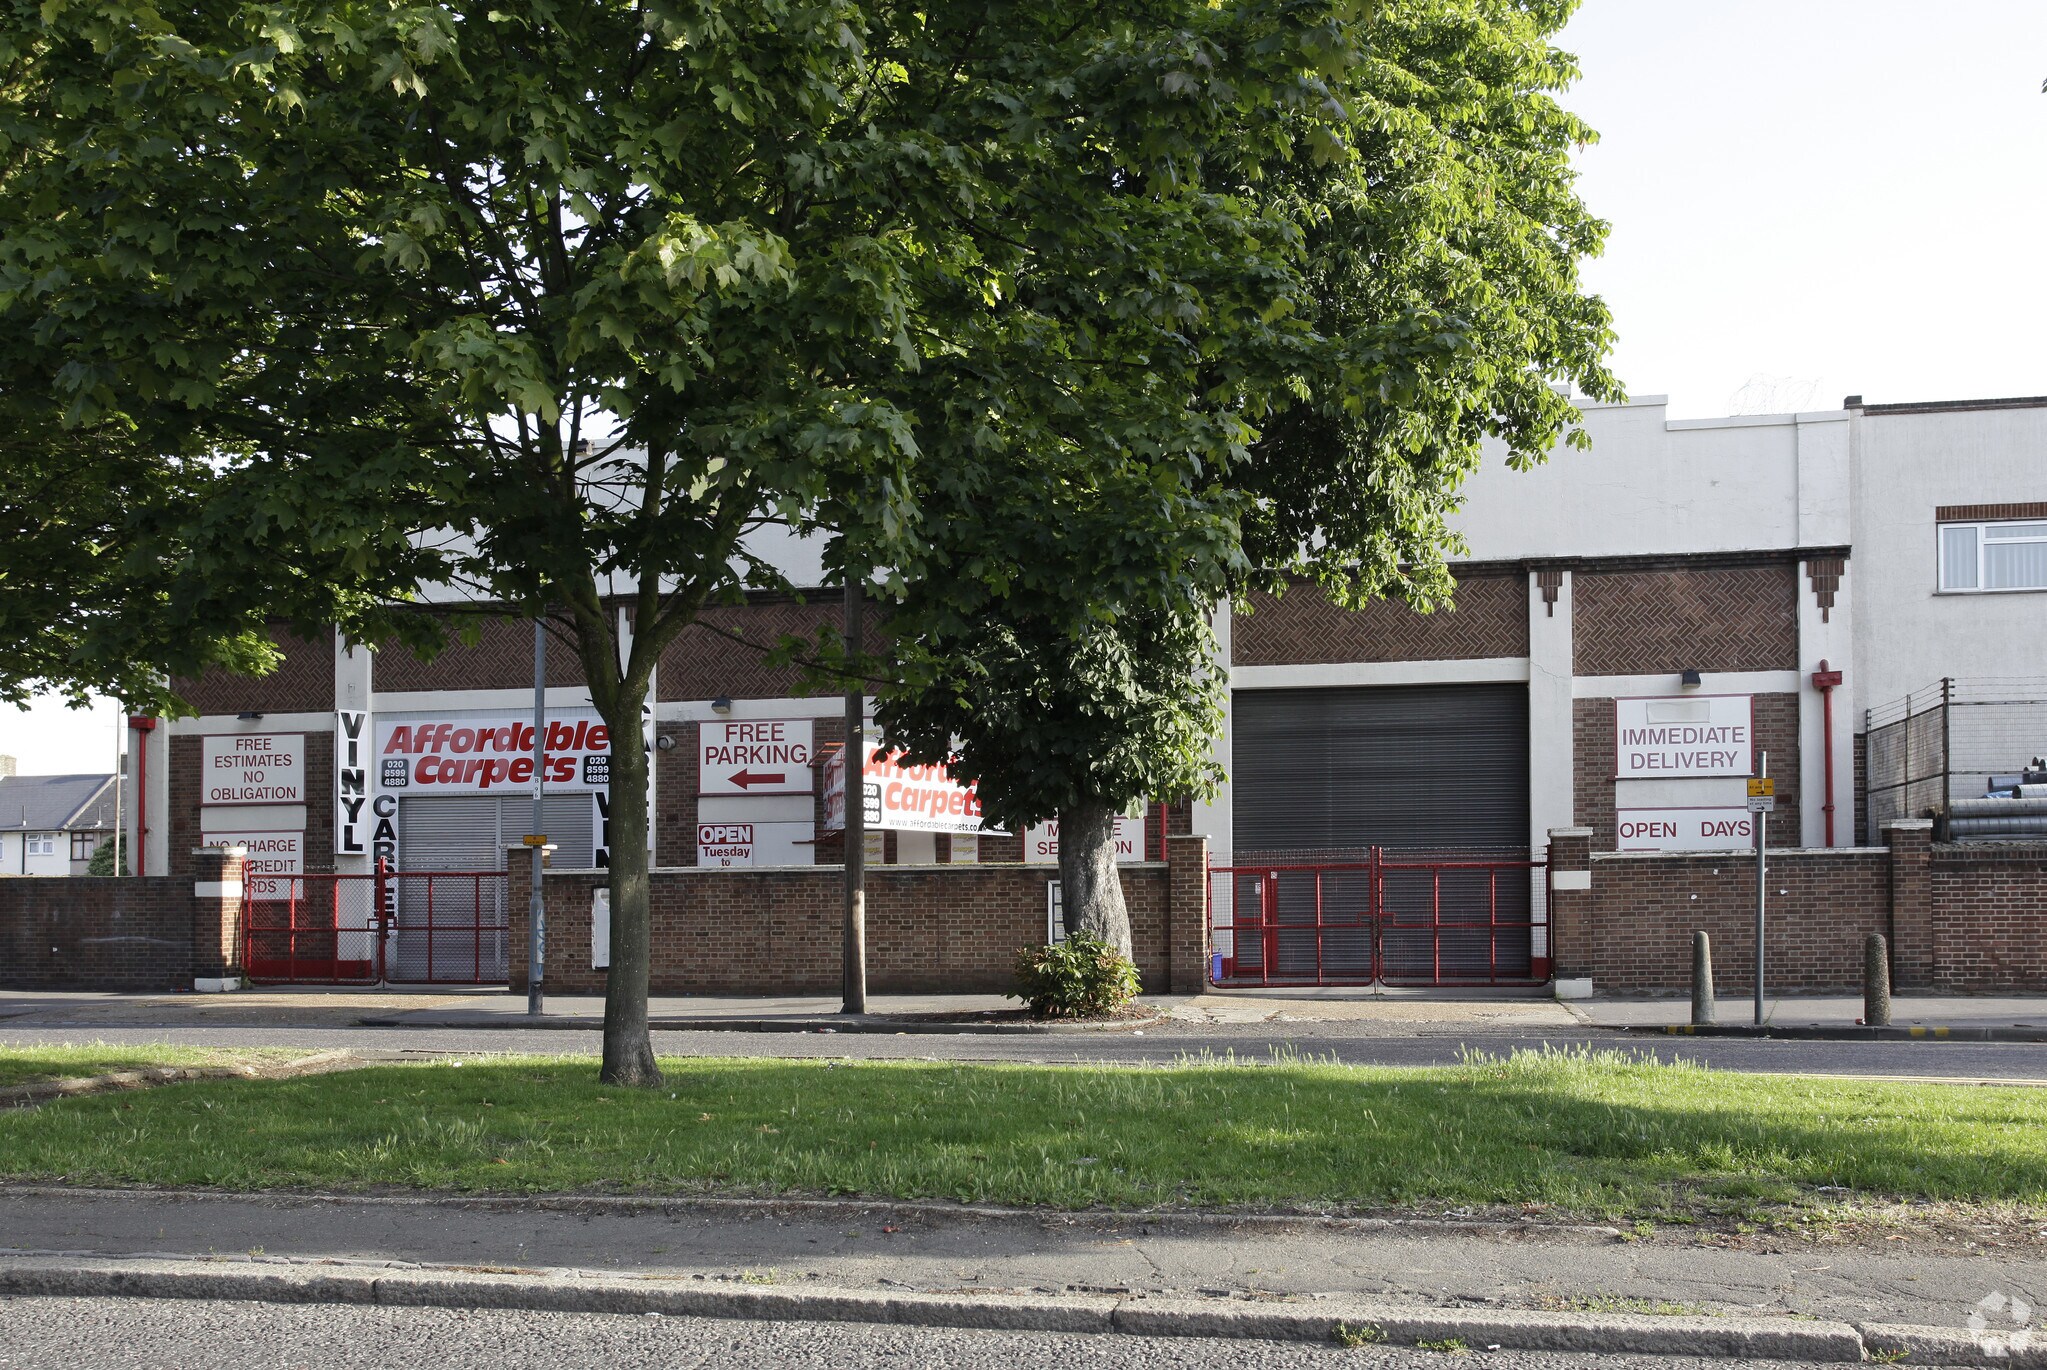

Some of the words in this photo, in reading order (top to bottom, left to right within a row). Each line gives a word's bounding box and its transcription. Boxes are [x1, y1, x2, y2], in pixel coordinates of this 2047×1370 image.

[383, 720, 609, 755] Affordable
[725, 722, 785, 743] FREE
[1622, 726, 1746, 746] IMMEDIATE
[235, 738, 272, 751] FREE
[214, 753, 292, 768] ESTIMATES
[589, 756, 607, 765] 020
[705, 744, 807, 765] PARKING
[1630, 751, 1738, 770] DELIVERY
[387, 760, 404, 769] 020
[414, 753, 577, 789] Carpets
[586, 765, 609, 774] 8599
[243, 770, 265, 783] NO
[384, 768, 406, 778] 8599
[586, 774, 609, 783] 4880
[340, 712, 366, 852] VINYL
[384, 777, 406, 787] 4880
[211, 786, 297, 800] OBLIGATION
[863, 797, 880, 809] 599
[863, 810, 880, 821] 880
[700, 826, 750, 843] OPEN
[1619, 821, 1677, 838] OPEN
[1701, 821, 1751, 837] DAYS
[237, 839, 297, 852] CHARGE
[703, 846, 750, 858] Tuesday
[721, 858, 731, 866] to
